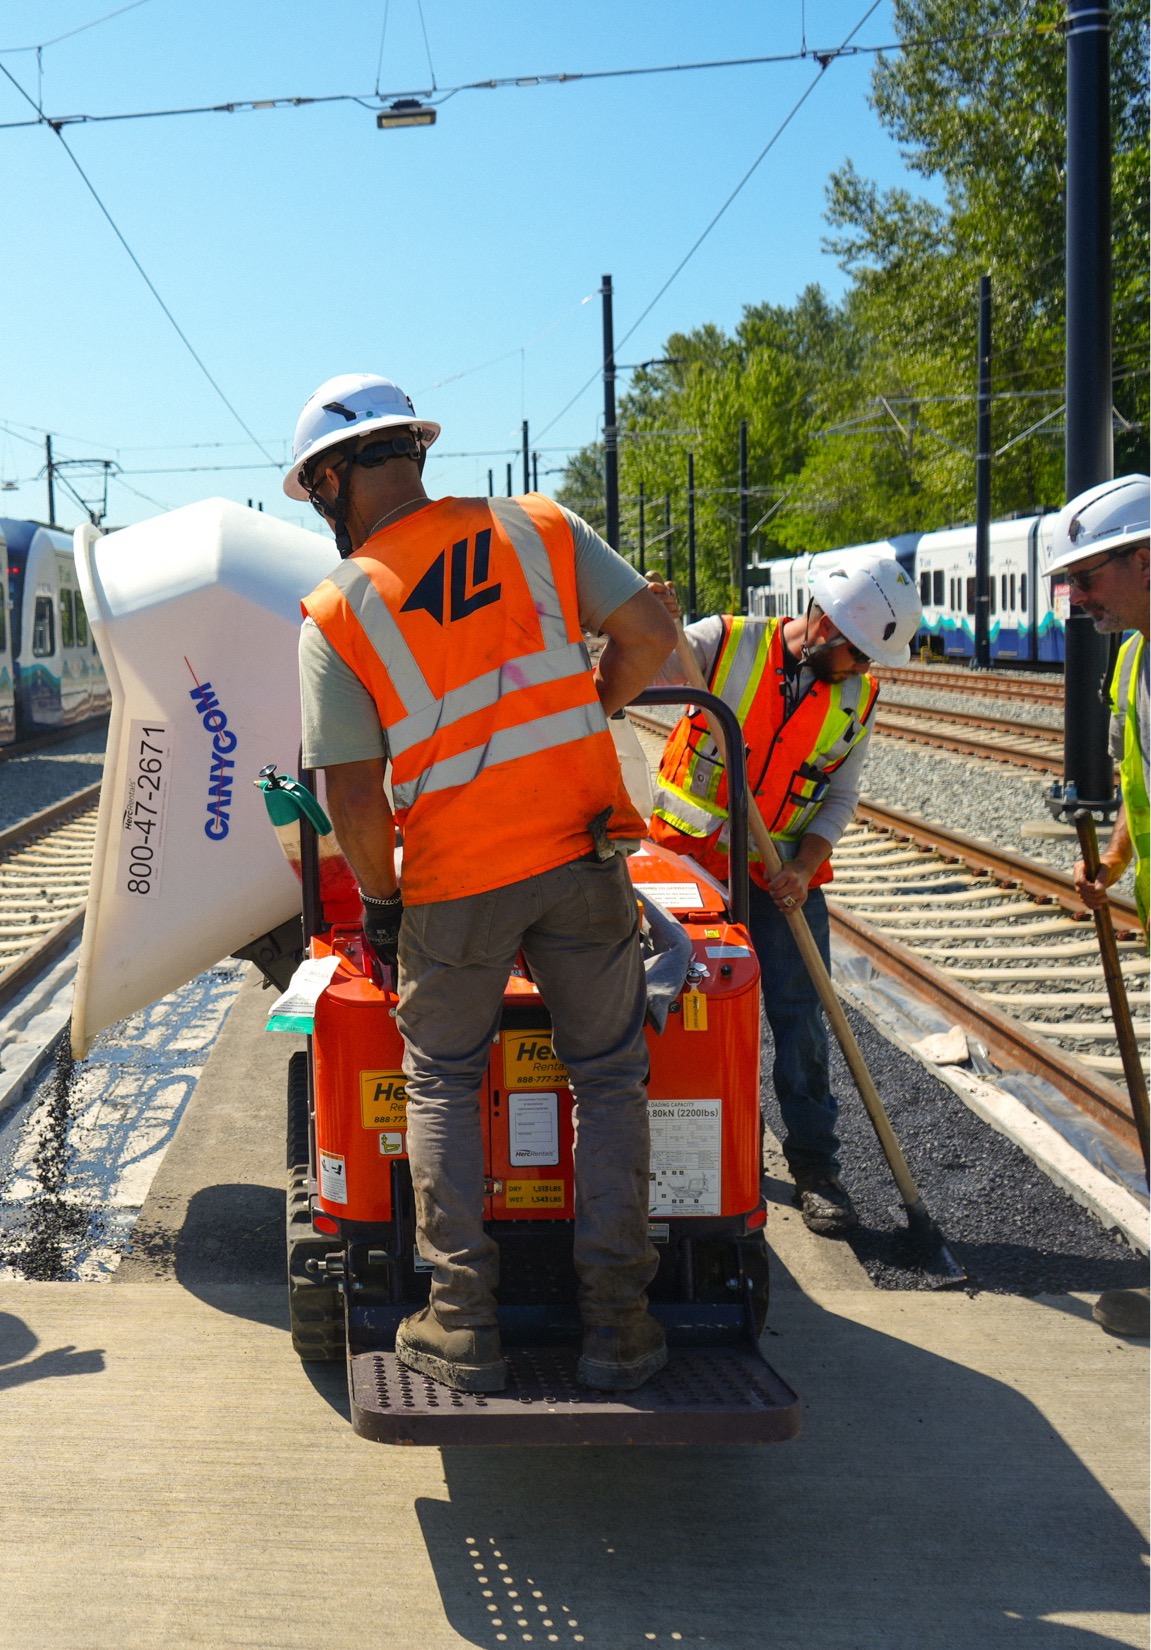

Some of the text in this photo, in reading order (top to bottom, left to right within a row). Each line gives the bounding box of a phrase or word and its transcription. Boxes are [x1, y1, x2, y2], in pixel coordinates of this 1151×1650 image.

[189, 682, 238, 841] CANYCOM
[127, 727, 166, 895] 800-47-2671
[517, 1042, 557, 1061] He
[533, 1063, 567, 1071] Renta
[373, 1082, 409, 1102] He
[374, 1115, 407, 1123] 888-777
[677, 1108, 719, 1119] (2200lbs)
